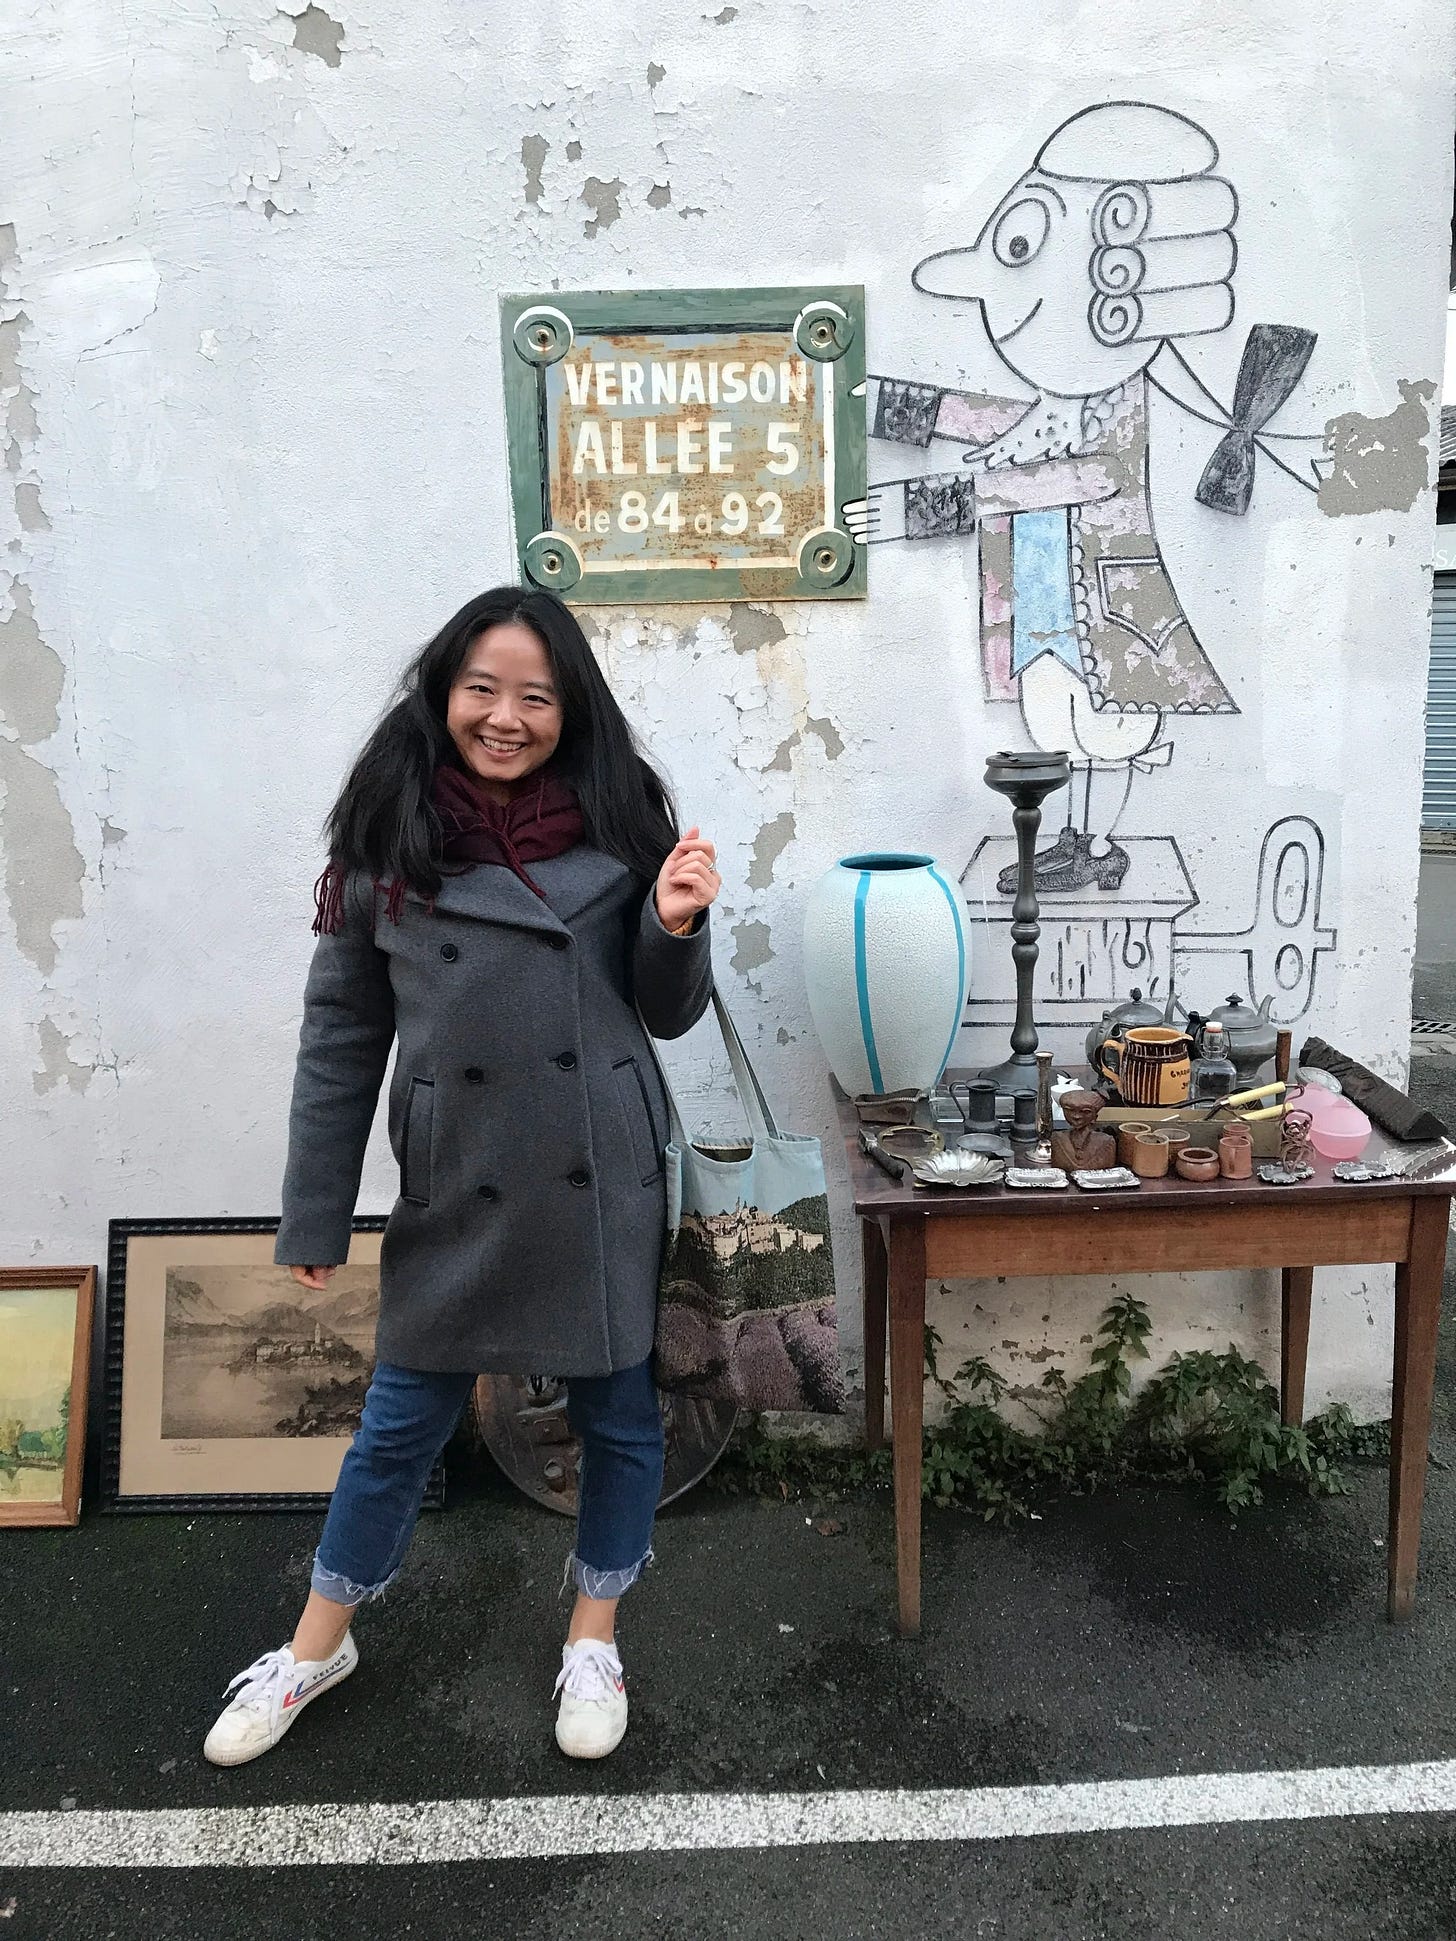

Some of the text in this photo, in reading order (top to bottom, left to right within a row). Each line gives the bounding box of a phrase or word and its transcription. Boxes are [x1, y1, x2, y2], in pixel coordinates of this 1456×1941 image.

[564, 361, 807, 405] VERNAISON
[572, 417, 801, 476] ALLÉE 5
[574, 498, 611, 534] de
[617, 490, 686, 534] 84
[719, 491, 785, 536] 92
